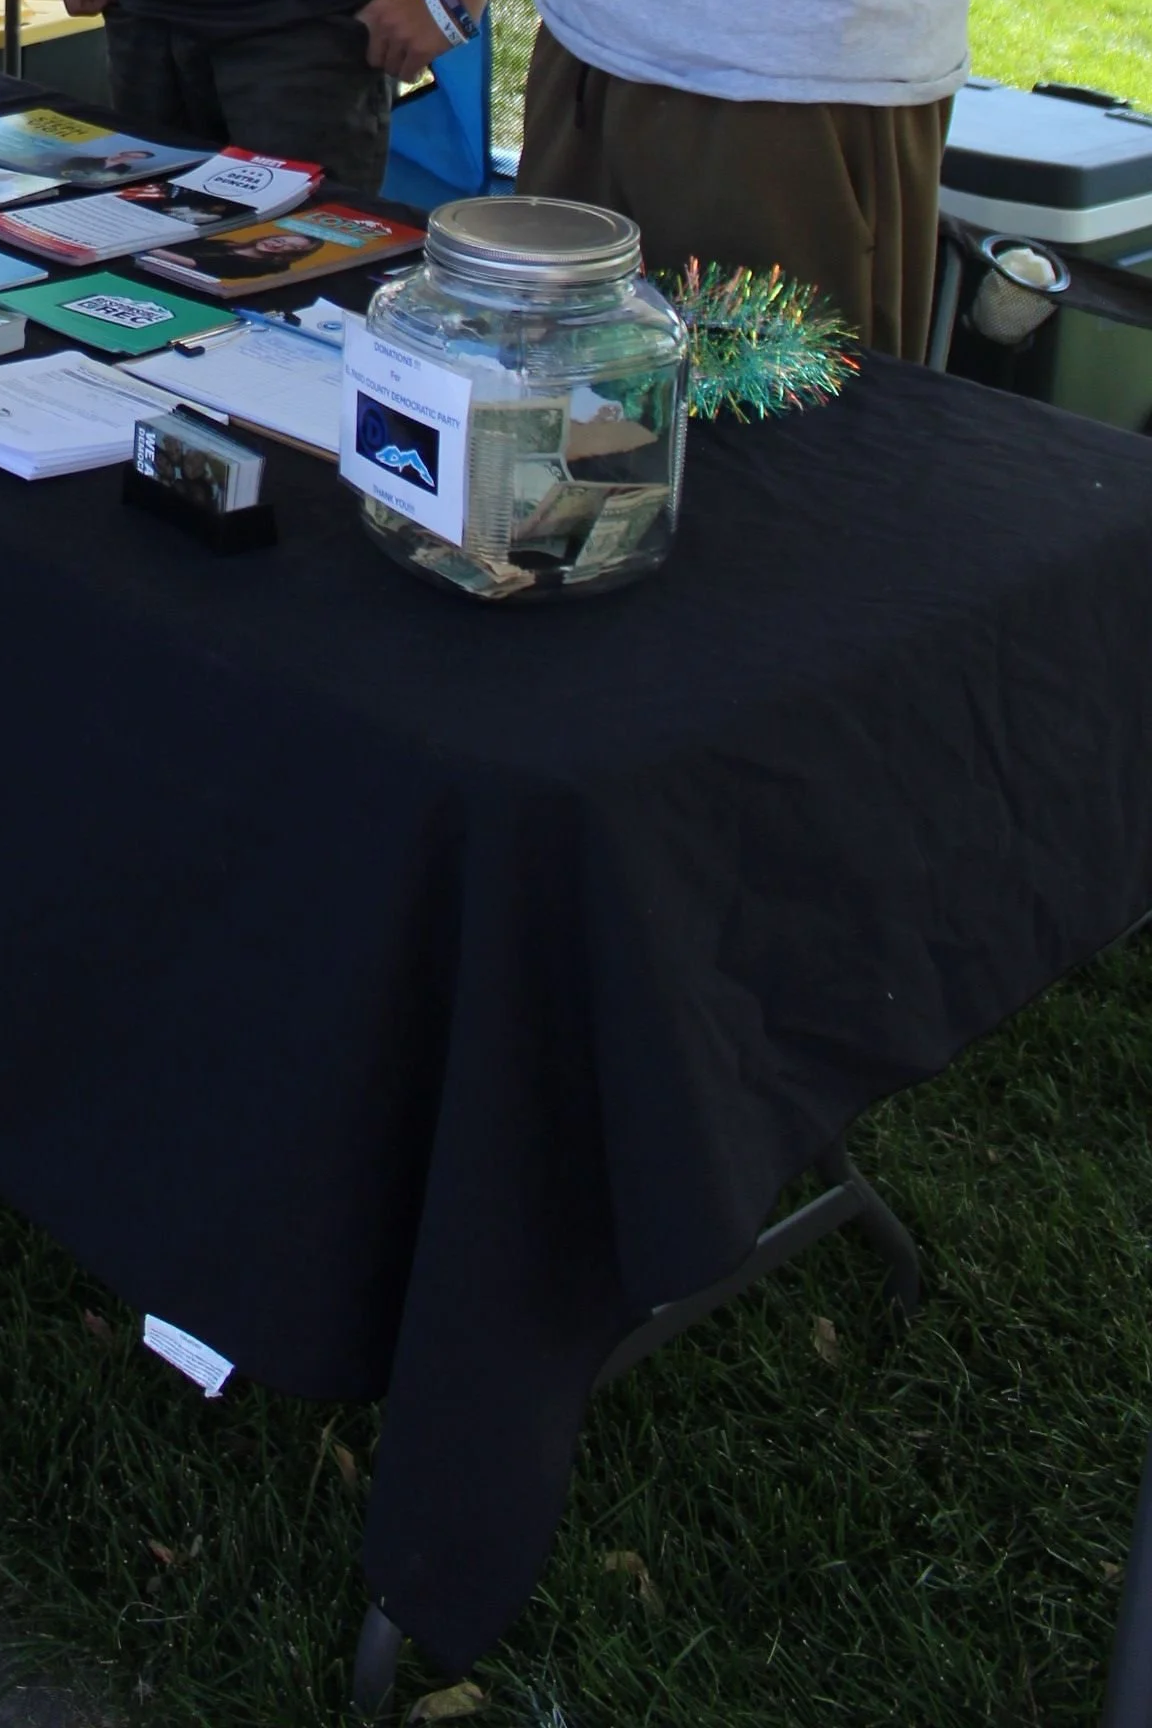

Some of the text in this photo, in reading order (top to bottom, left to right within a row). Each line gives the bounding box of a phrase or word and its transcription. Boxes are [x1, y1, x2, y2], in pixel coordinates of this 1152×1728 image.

[374, 341, 413, 368] DONATIONS
[365, 377, 390, 397] COUNTY
[391, 391, 436, 420] DEMOCRATIC
[437, 412, 461, 429] PARTY
[145, 432, 156, 462] WE
